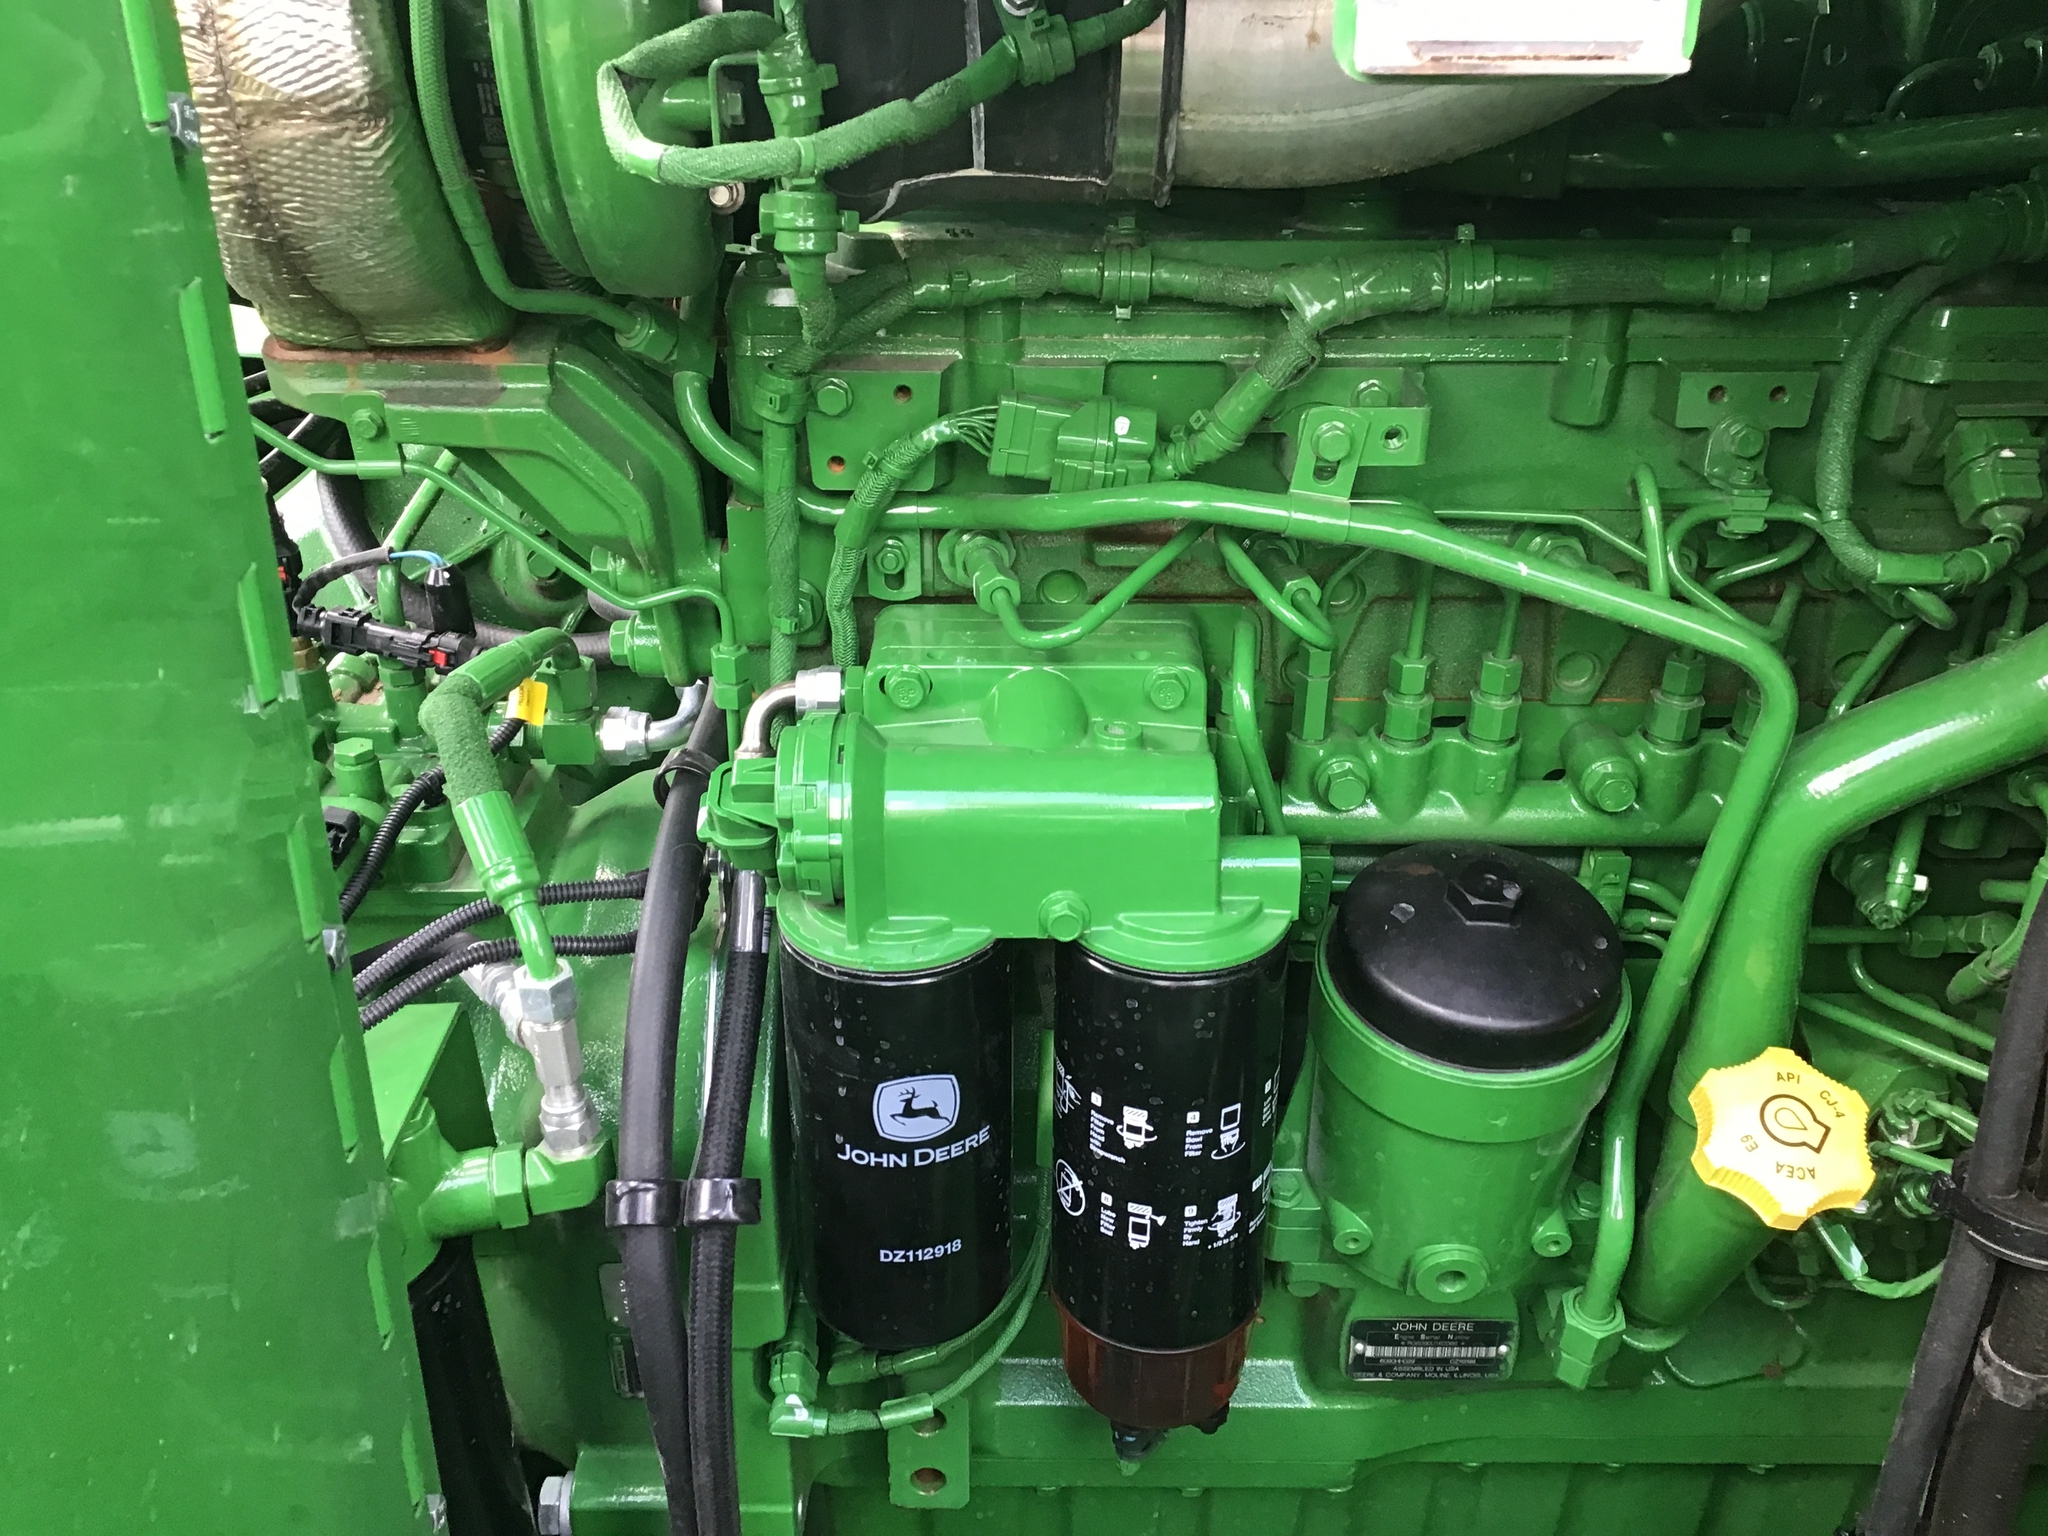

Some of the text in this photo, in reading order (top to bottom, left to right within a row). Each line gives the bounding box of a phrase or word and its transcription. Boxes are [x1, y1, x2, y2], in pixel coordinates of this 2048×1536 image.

[1776, 1071, 1801, 1085] API
[1819, 1090, 1846, 1118] CJ-4
[1090, 1109, 1114, 1126] Remove
[1186, 1128, 1213, 1137] Remove
[837, 1125, 991, 1168] JOHN DEERE
[1740, 1134, 1759, 1153] E9
[1776, 1161, 1816, 1180] ACEA
[1101, 1206, 1117, 1218] Lube
[1183, 1218, 1208, 1227] Tighten
[1183, 1226, 1204, 1234] Firmly
[1182, 1239, 1200, 1247] Hand
[879, 1238, 962, 1263] DZ112918
[1392, 1322, 1475, 1332] JOHN DEERE
